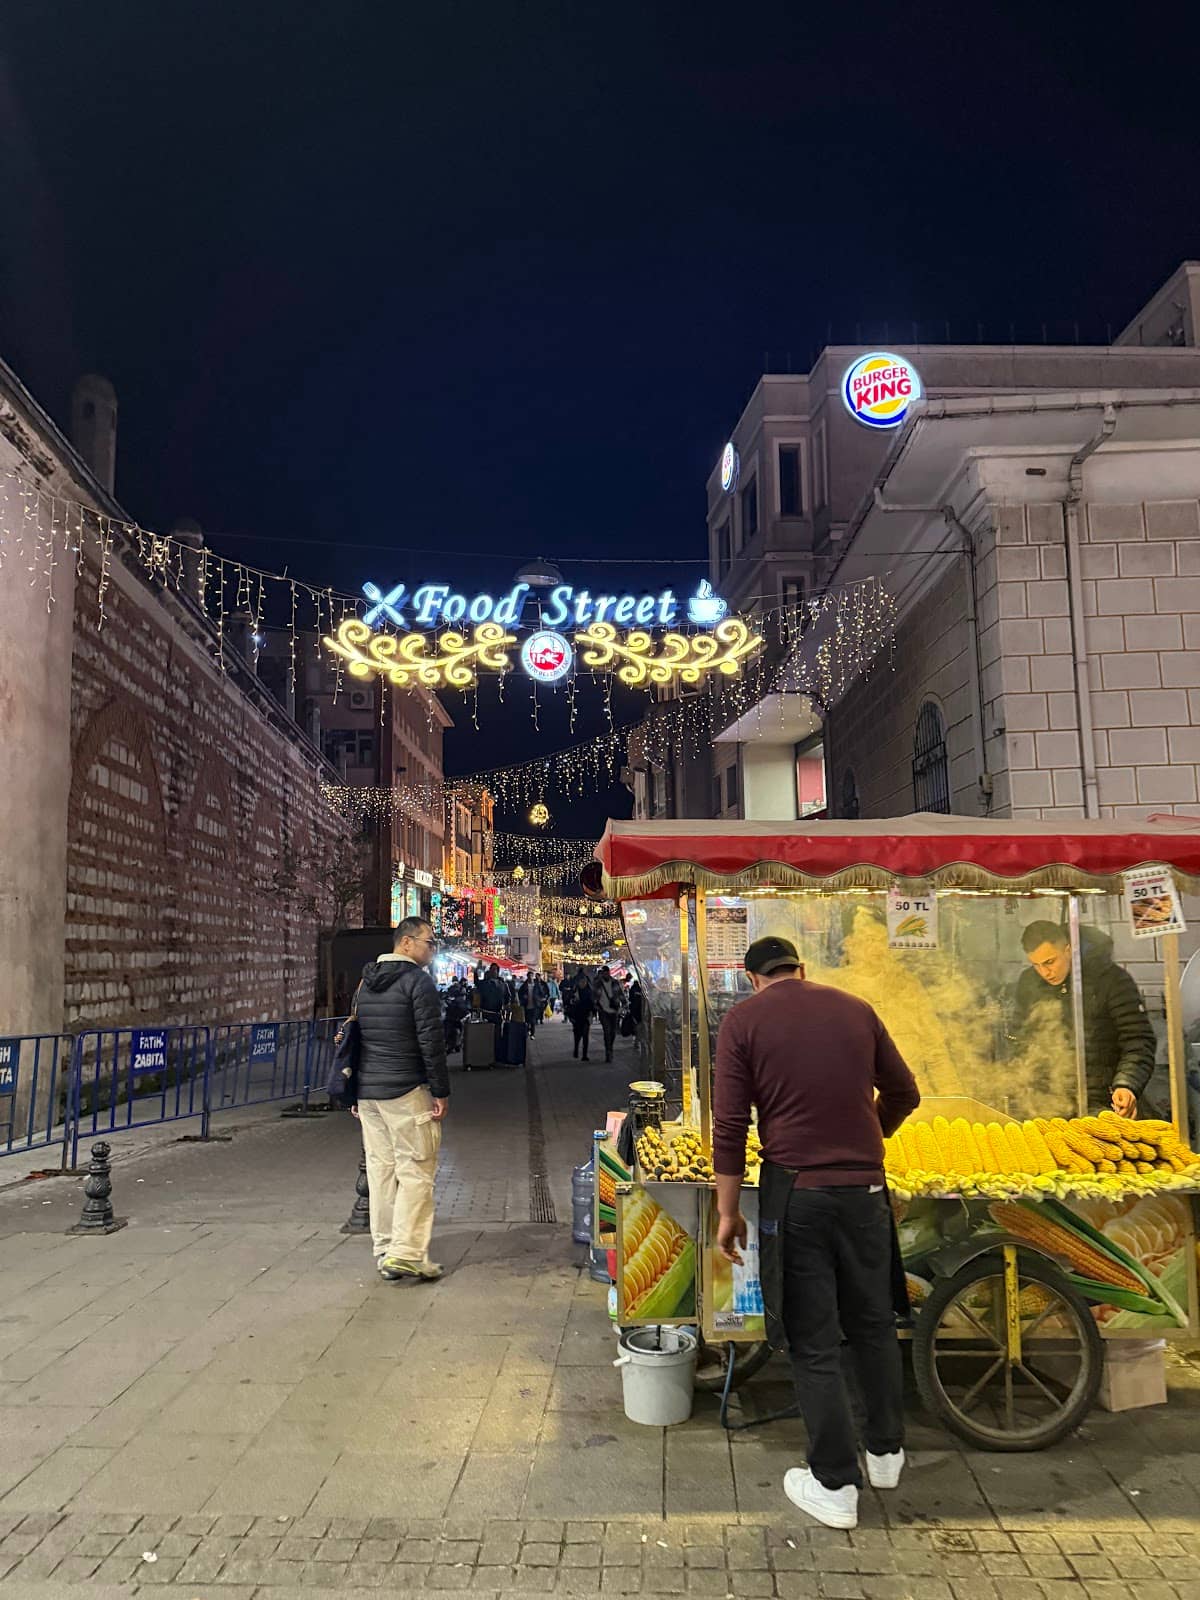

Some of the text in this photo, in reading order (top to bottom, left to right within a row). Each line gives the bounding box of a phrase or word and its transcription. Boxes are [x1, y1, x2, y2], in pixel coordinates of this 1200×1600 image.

[854, 367, 908, 391] BURGER
[856, 378, 911, 410] KING
[413, 584, 675, 625] Food Street
[1133, 885, 1167, 898] 50 TL
[895, 901, 930, 911] 50 TL
[134, 1052, 164, 1069] ZABITA
